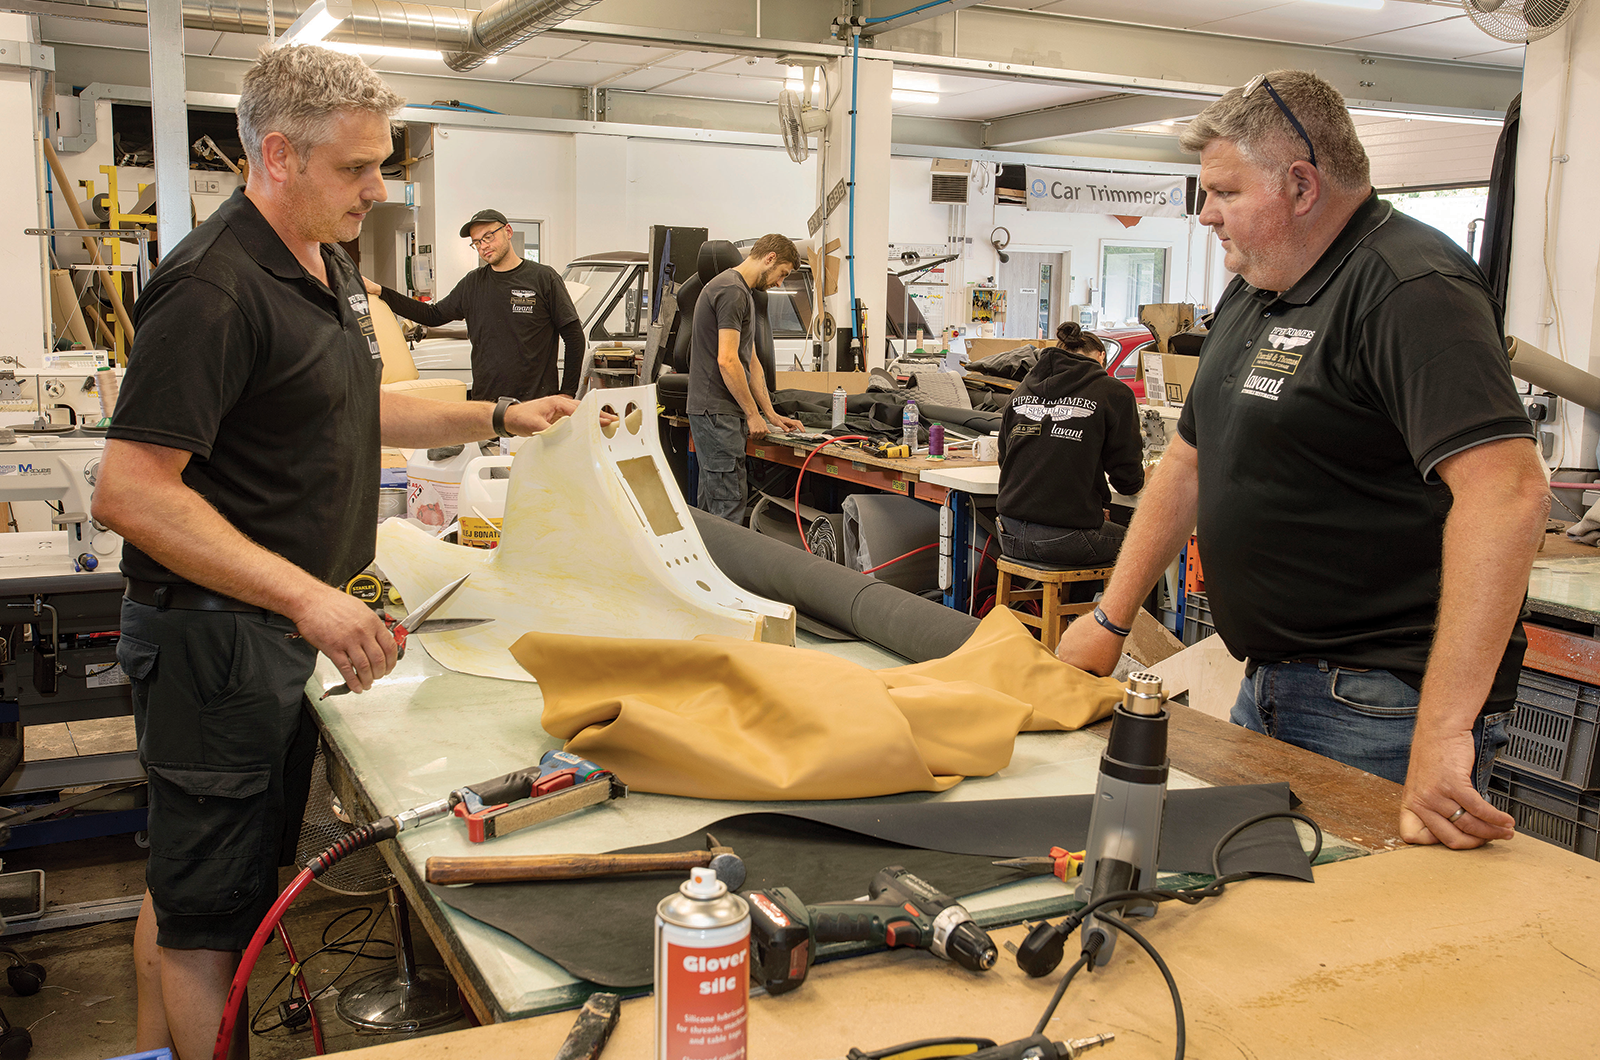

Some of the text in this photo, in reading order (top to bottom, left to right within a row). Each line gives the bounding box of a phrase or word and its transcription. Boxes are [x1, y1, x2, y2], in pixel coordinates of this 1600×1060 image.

[1051, 181, 1167, 205] Car Trimmers
[1243, 368, 1285, 394] lavant
[1012, 395, 1039, 407] PIPER
[1051, 423, 1083, 438] lavant
[683, 948, 747, 972] Glover
[699, 976, 736, 995] silc
[684, 1013, 715, 1023] Silicone
[676, 1023, 688, 1033] for
[689, 1036, 704, 1045] and
[707, 1034, 726, 1045] table
